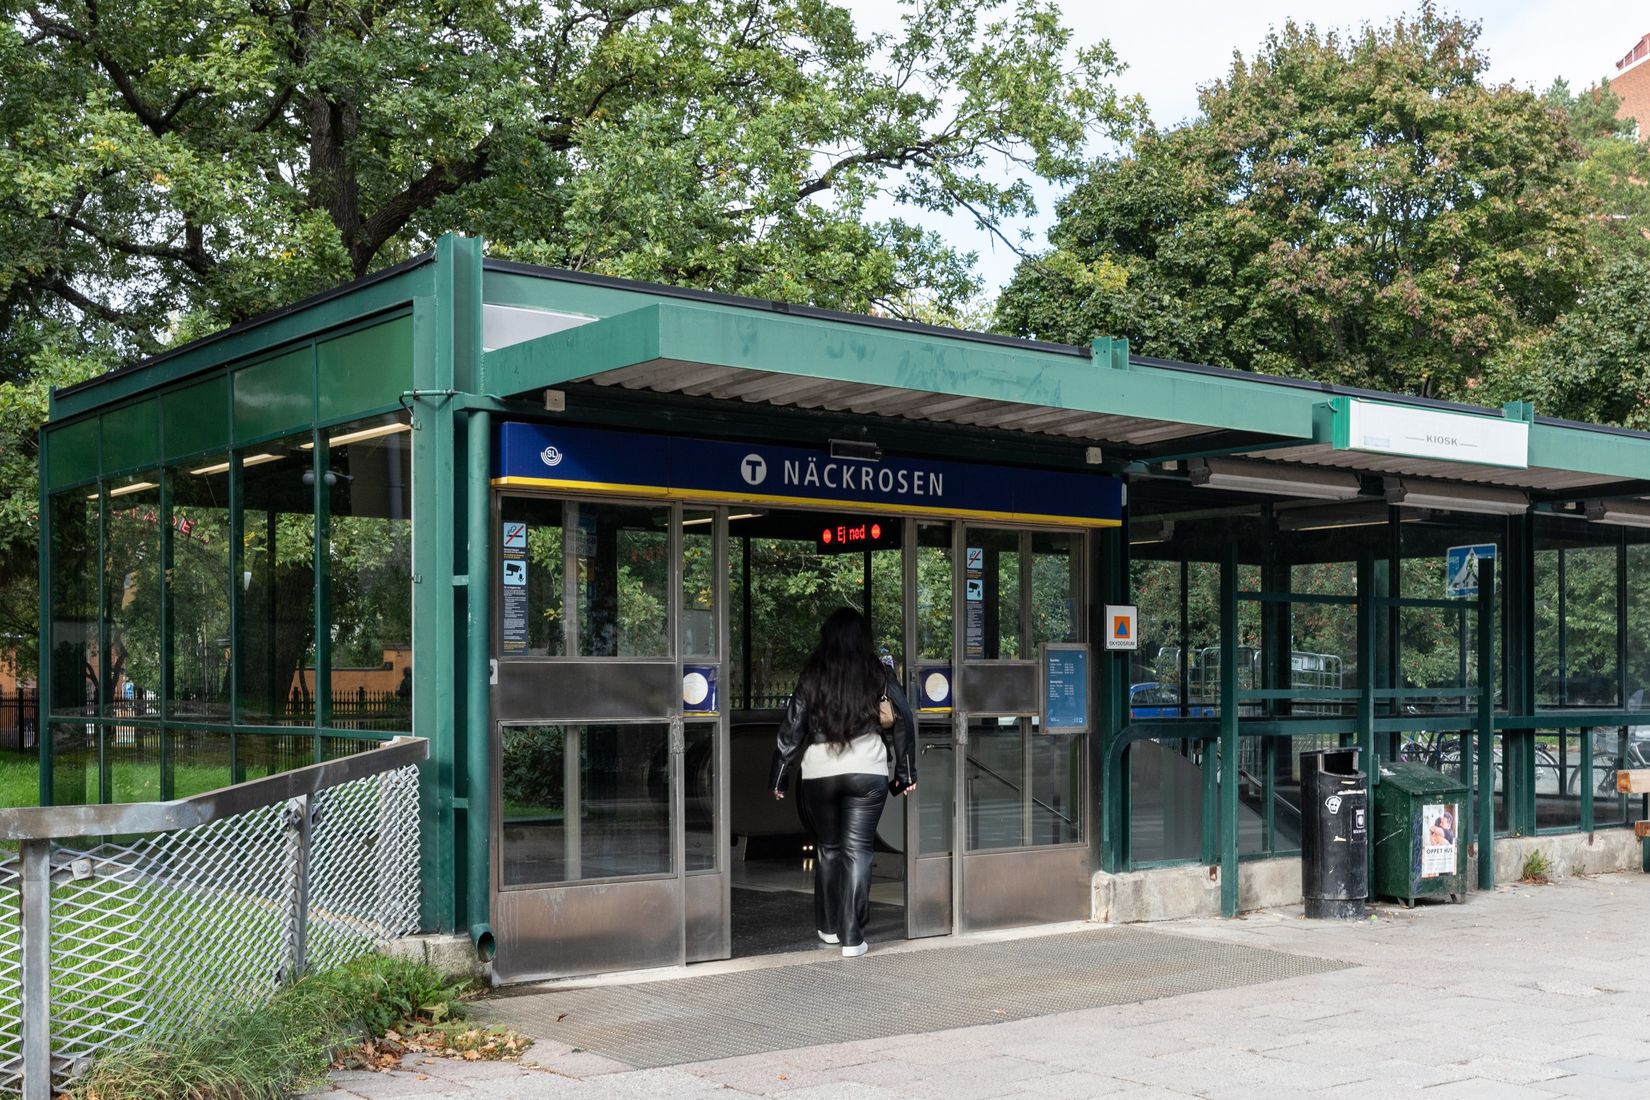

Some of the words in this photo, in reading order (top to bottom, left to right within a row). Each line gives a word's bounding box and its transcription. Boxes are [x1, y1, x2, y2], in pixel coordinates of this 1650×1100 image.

[1426, 434, 1458, 446] KIOSK
[745, 459, 763, 482] T
[784, 456, 943, 496] NÄCKROSEN
[837, 526, 846, 544] Ej
[849, 524, 866, 540] ned
